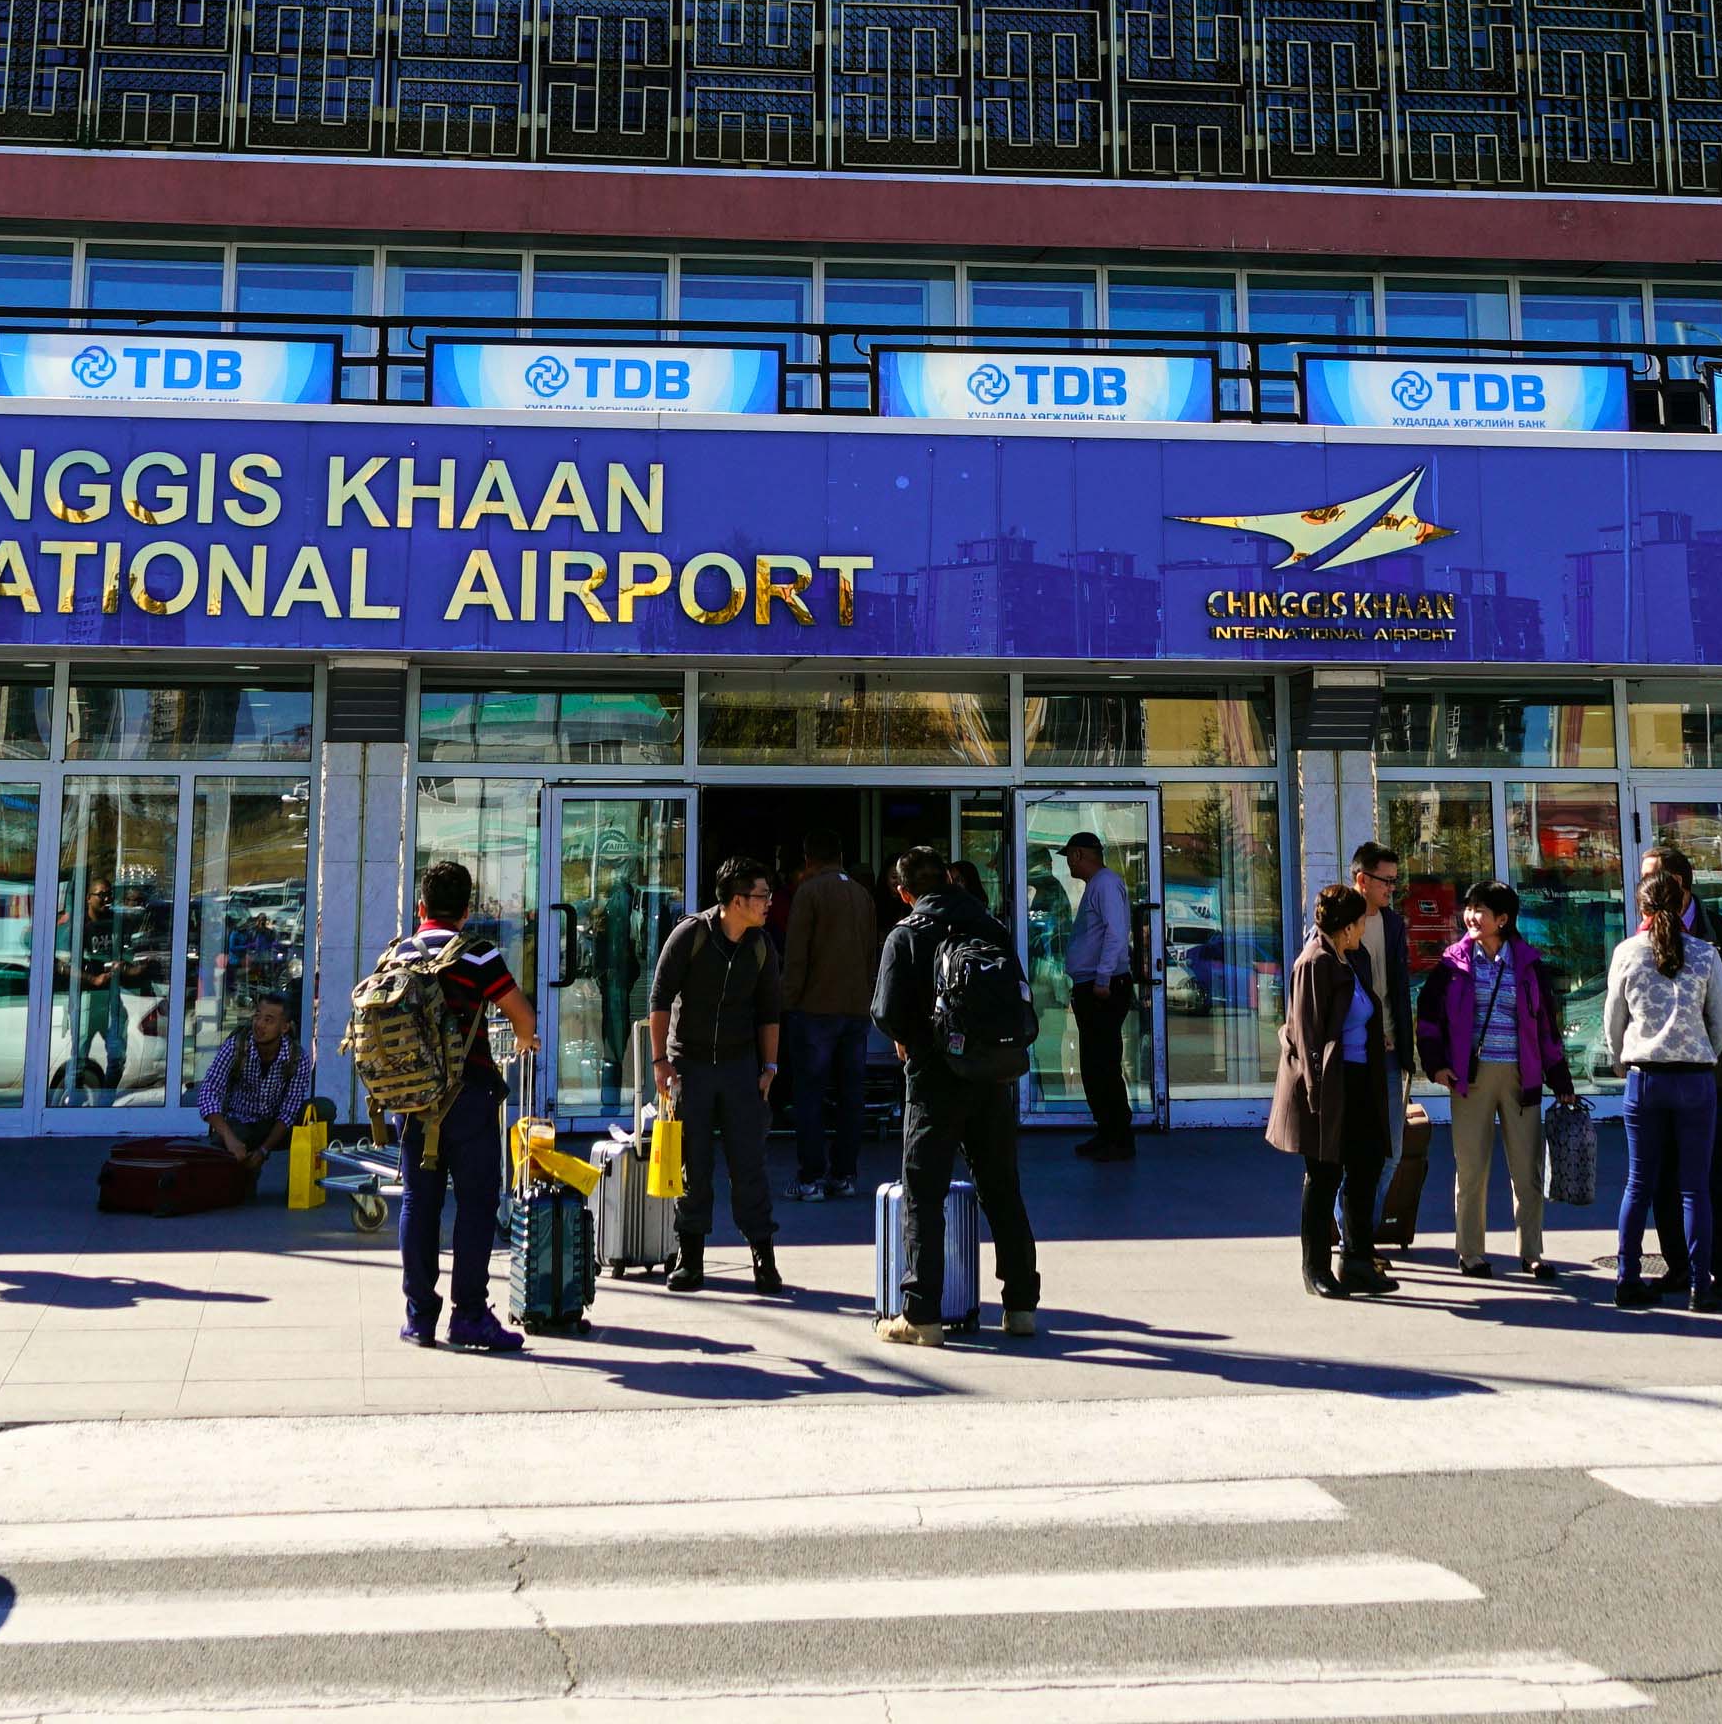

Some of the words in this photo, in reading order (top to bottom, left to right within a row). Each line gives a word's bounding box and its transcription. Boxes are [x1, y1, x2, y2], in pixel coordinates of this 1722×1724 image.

[123, 348, 242, 390] TDB
[575, 358, 690, 399] TDB
[1015, 366, 1127, 406] TDB
[1437, 372, 1546, 412] TDB
[1392, 417, 1449, 428] ХУДАЛДАА
[1518, 420, 1546, 429] БАНК
[326, 455, 664, 534] KHAAN
[444, 549, 874, 627] AIRPORT
[1206, 590, 1348, 620] CHINGGIS
[1354, 592, 1456, 621] KHAAN
[1210, 626, 1366, 642] INTERNATIONAL
[1373, 628, 1457, 643] AIRPORT
